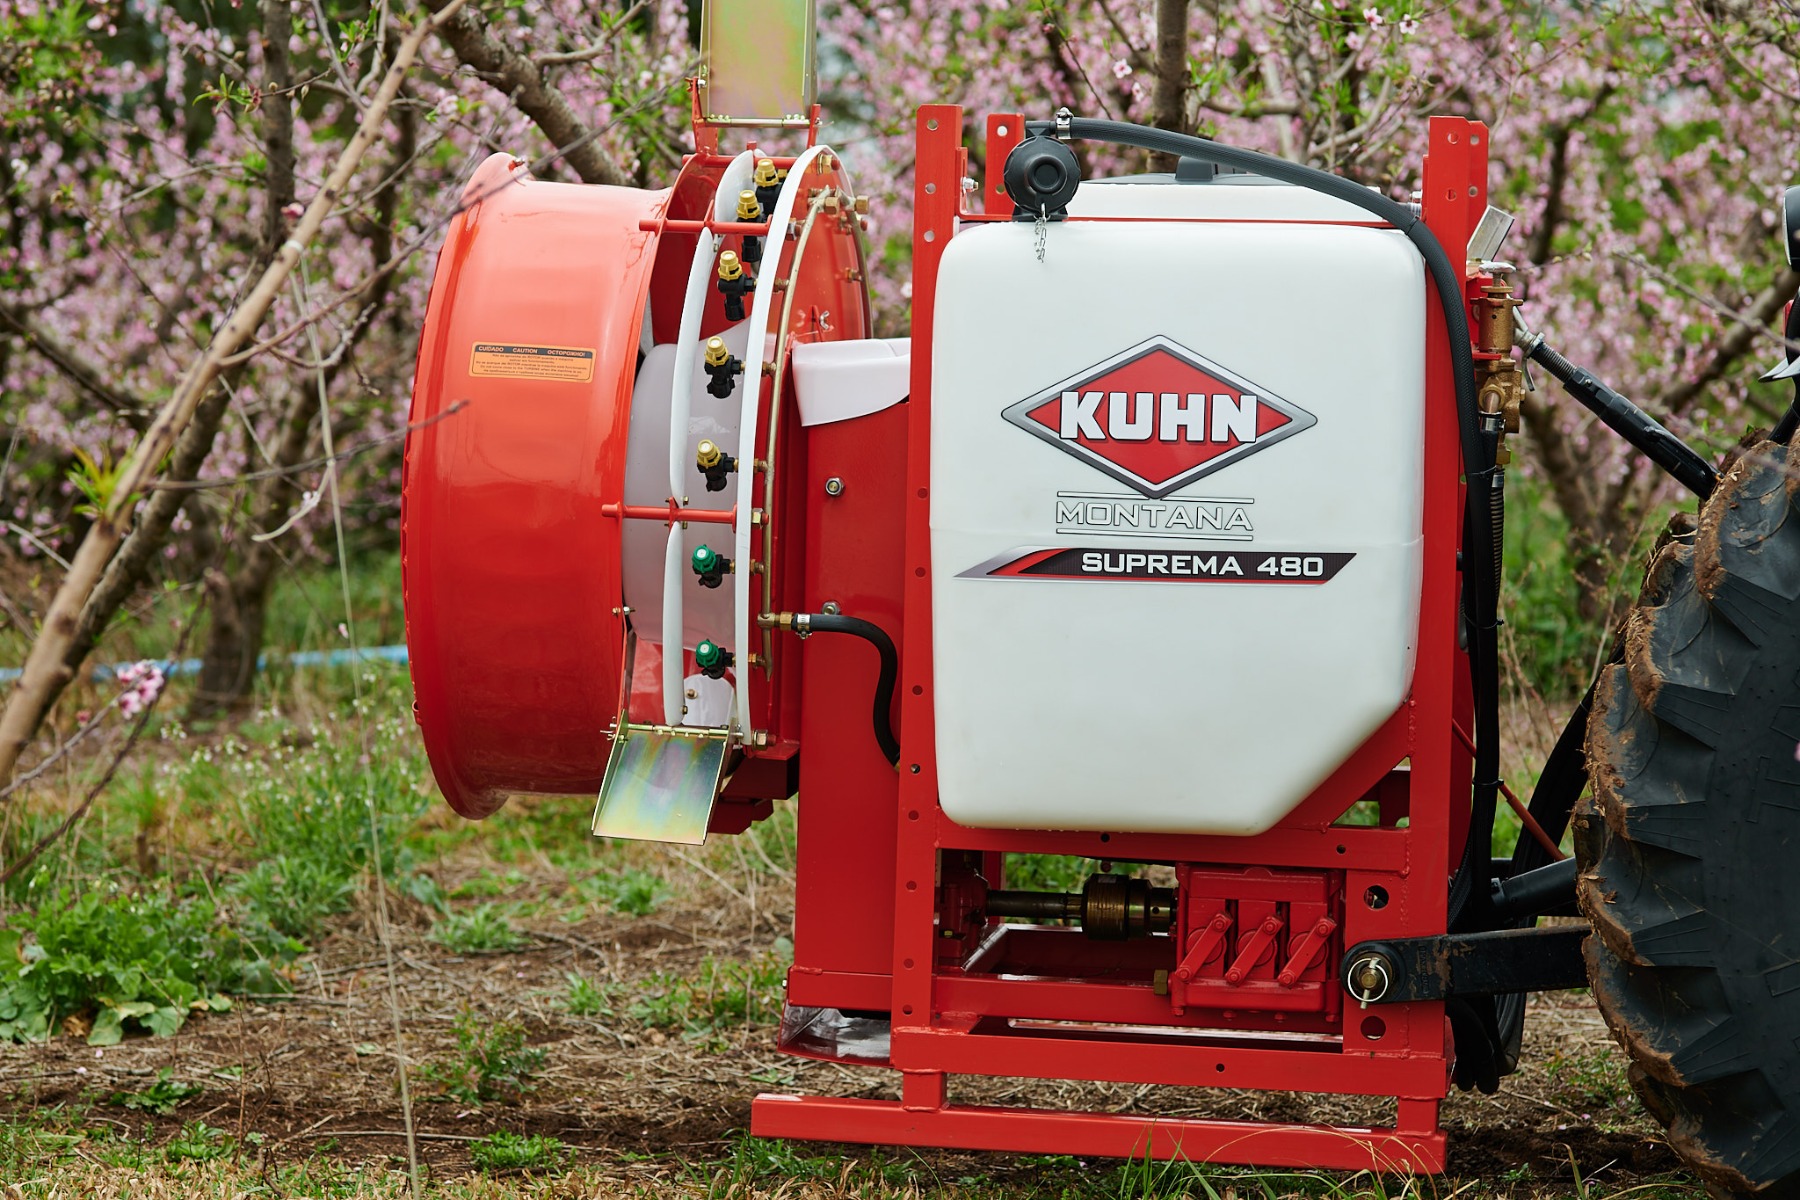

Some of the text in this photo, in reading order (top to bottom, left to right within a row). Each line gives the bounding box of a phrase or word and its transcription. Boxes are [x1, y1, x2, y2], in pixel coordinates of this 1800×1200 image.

[1058, 391, 1258, 444] KUHN
[1055, 501, 1254, 531] MONTANA
[1081, 552, 1324, 577] SUPREMA 480
